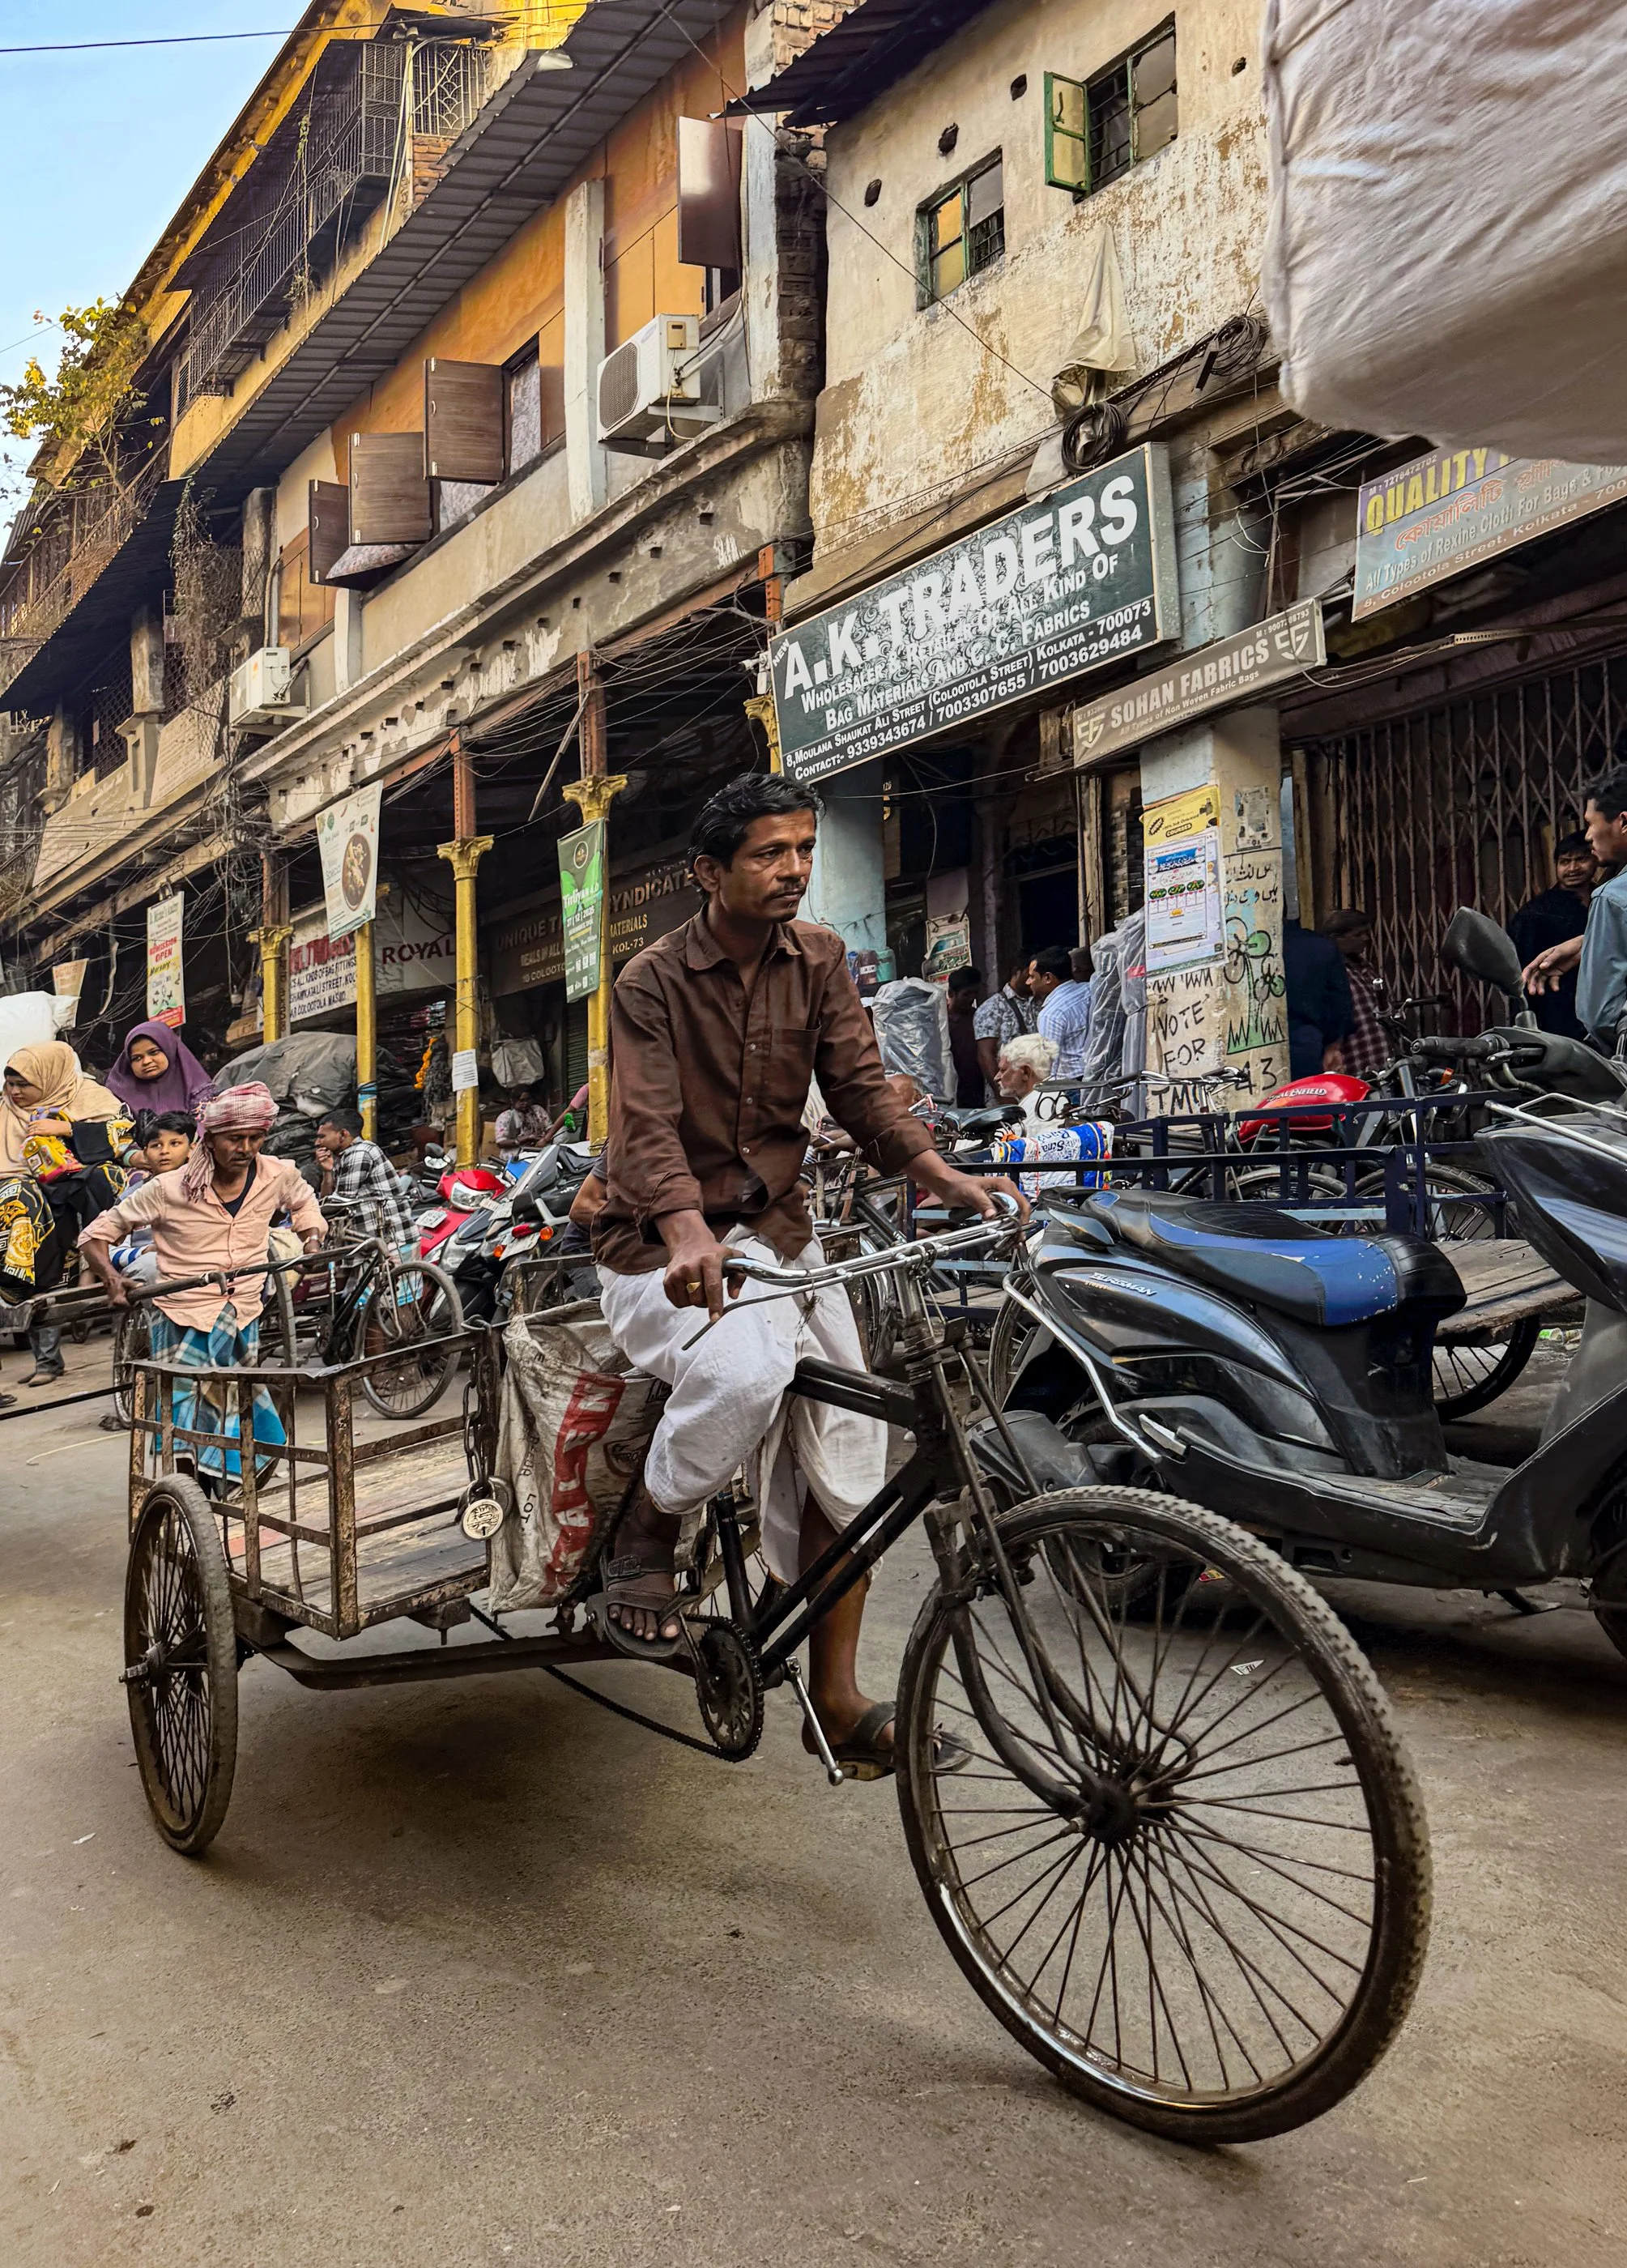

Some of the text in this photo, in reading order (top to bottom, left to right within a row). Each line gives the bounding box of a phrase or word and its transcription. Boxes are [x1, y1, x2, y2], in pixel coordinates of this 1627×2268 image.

[1366, 447, 1488, 536] QUALITY
[1365, 569, 1381, 591] All
[1383, 556, 1417, 583] Types
[1420, 542, 1433, 562] of
[1435, 525, 1477, 557] Rexine
[1481, 505, 1513, 533] Cloth
[1518, 497, 1539, 518] For
[1544, 479, 1578, 504] Bags
[1582, 467, 1592, 487] &
[1381, 562, 1450, 599] Colootola
[1513, 502, 1578, 537] Kolkata
[880, 475, 1138, 653] TRADERS
[772, 638, 790, 667] NEW
[801, 665, 885, 714] WHOLESALER
[888, 650, 901, 673] &
[1008, 592, 1037, 621] ALL
[1044, 570, 1086, 603] KIND
[1093, 553, 1118, 580] OF
[825, 706, 853, 731] BAG
[857, 671, 930, 718] MATERIALS
[934, 656, 968, 684] AND
[1021, 600, 1091, 646] FABRICS
[834, 723, 872, 748] SHAUKAT
[875, 716, 890, 731] ALI
[892, 701, 926, 722] STREET
[928, 674, 988, 710] (COLOOTOLA
[990, 651, 1033, 681] STREET)
[1037, 633, 1086, 662] KOLKATA
[1097, 599, 1152, 636] 700073
[846, 715, 926, 760] 9339343674
[936, 673, 1026, 723] 7003307655
[1039, 625, 1144, 680] 7003629484
[1110, 680, 1174, 728] SOHAN
[1180, 638, 1270, 697] FABRICS
[1132, 717, 1153, 734] Types
[1156, 710, 1163, 720] of
[1165, 703, 1181, 714] Non
[1182, 692, 1208, 708] Woven
[1211, 680, 1236, 697] Fabric
[1238, 670, 1259, 684] Bags
[496, 920, 546, 951] UNIQUE
[609, 868, 694, 914] YNDICATE
[155, 949, 172, 962] OPEN
[382, 940, 456, 965] ROYAL
[531, 964, 565, 980] COLOOTO
[612, 937, 644, 954] KOL-73
[548, 944, 560, 959] ALL
[1157, 1000, 1205, 1042] VOTE
[1163, 1038, 1206, 1078] FOR
[1289, 1088, 1327, 1097] ENFIELD
[1088, 1272, 1157, 1296] BURGMAN
[520, 1492, 536, 1524] LOT
